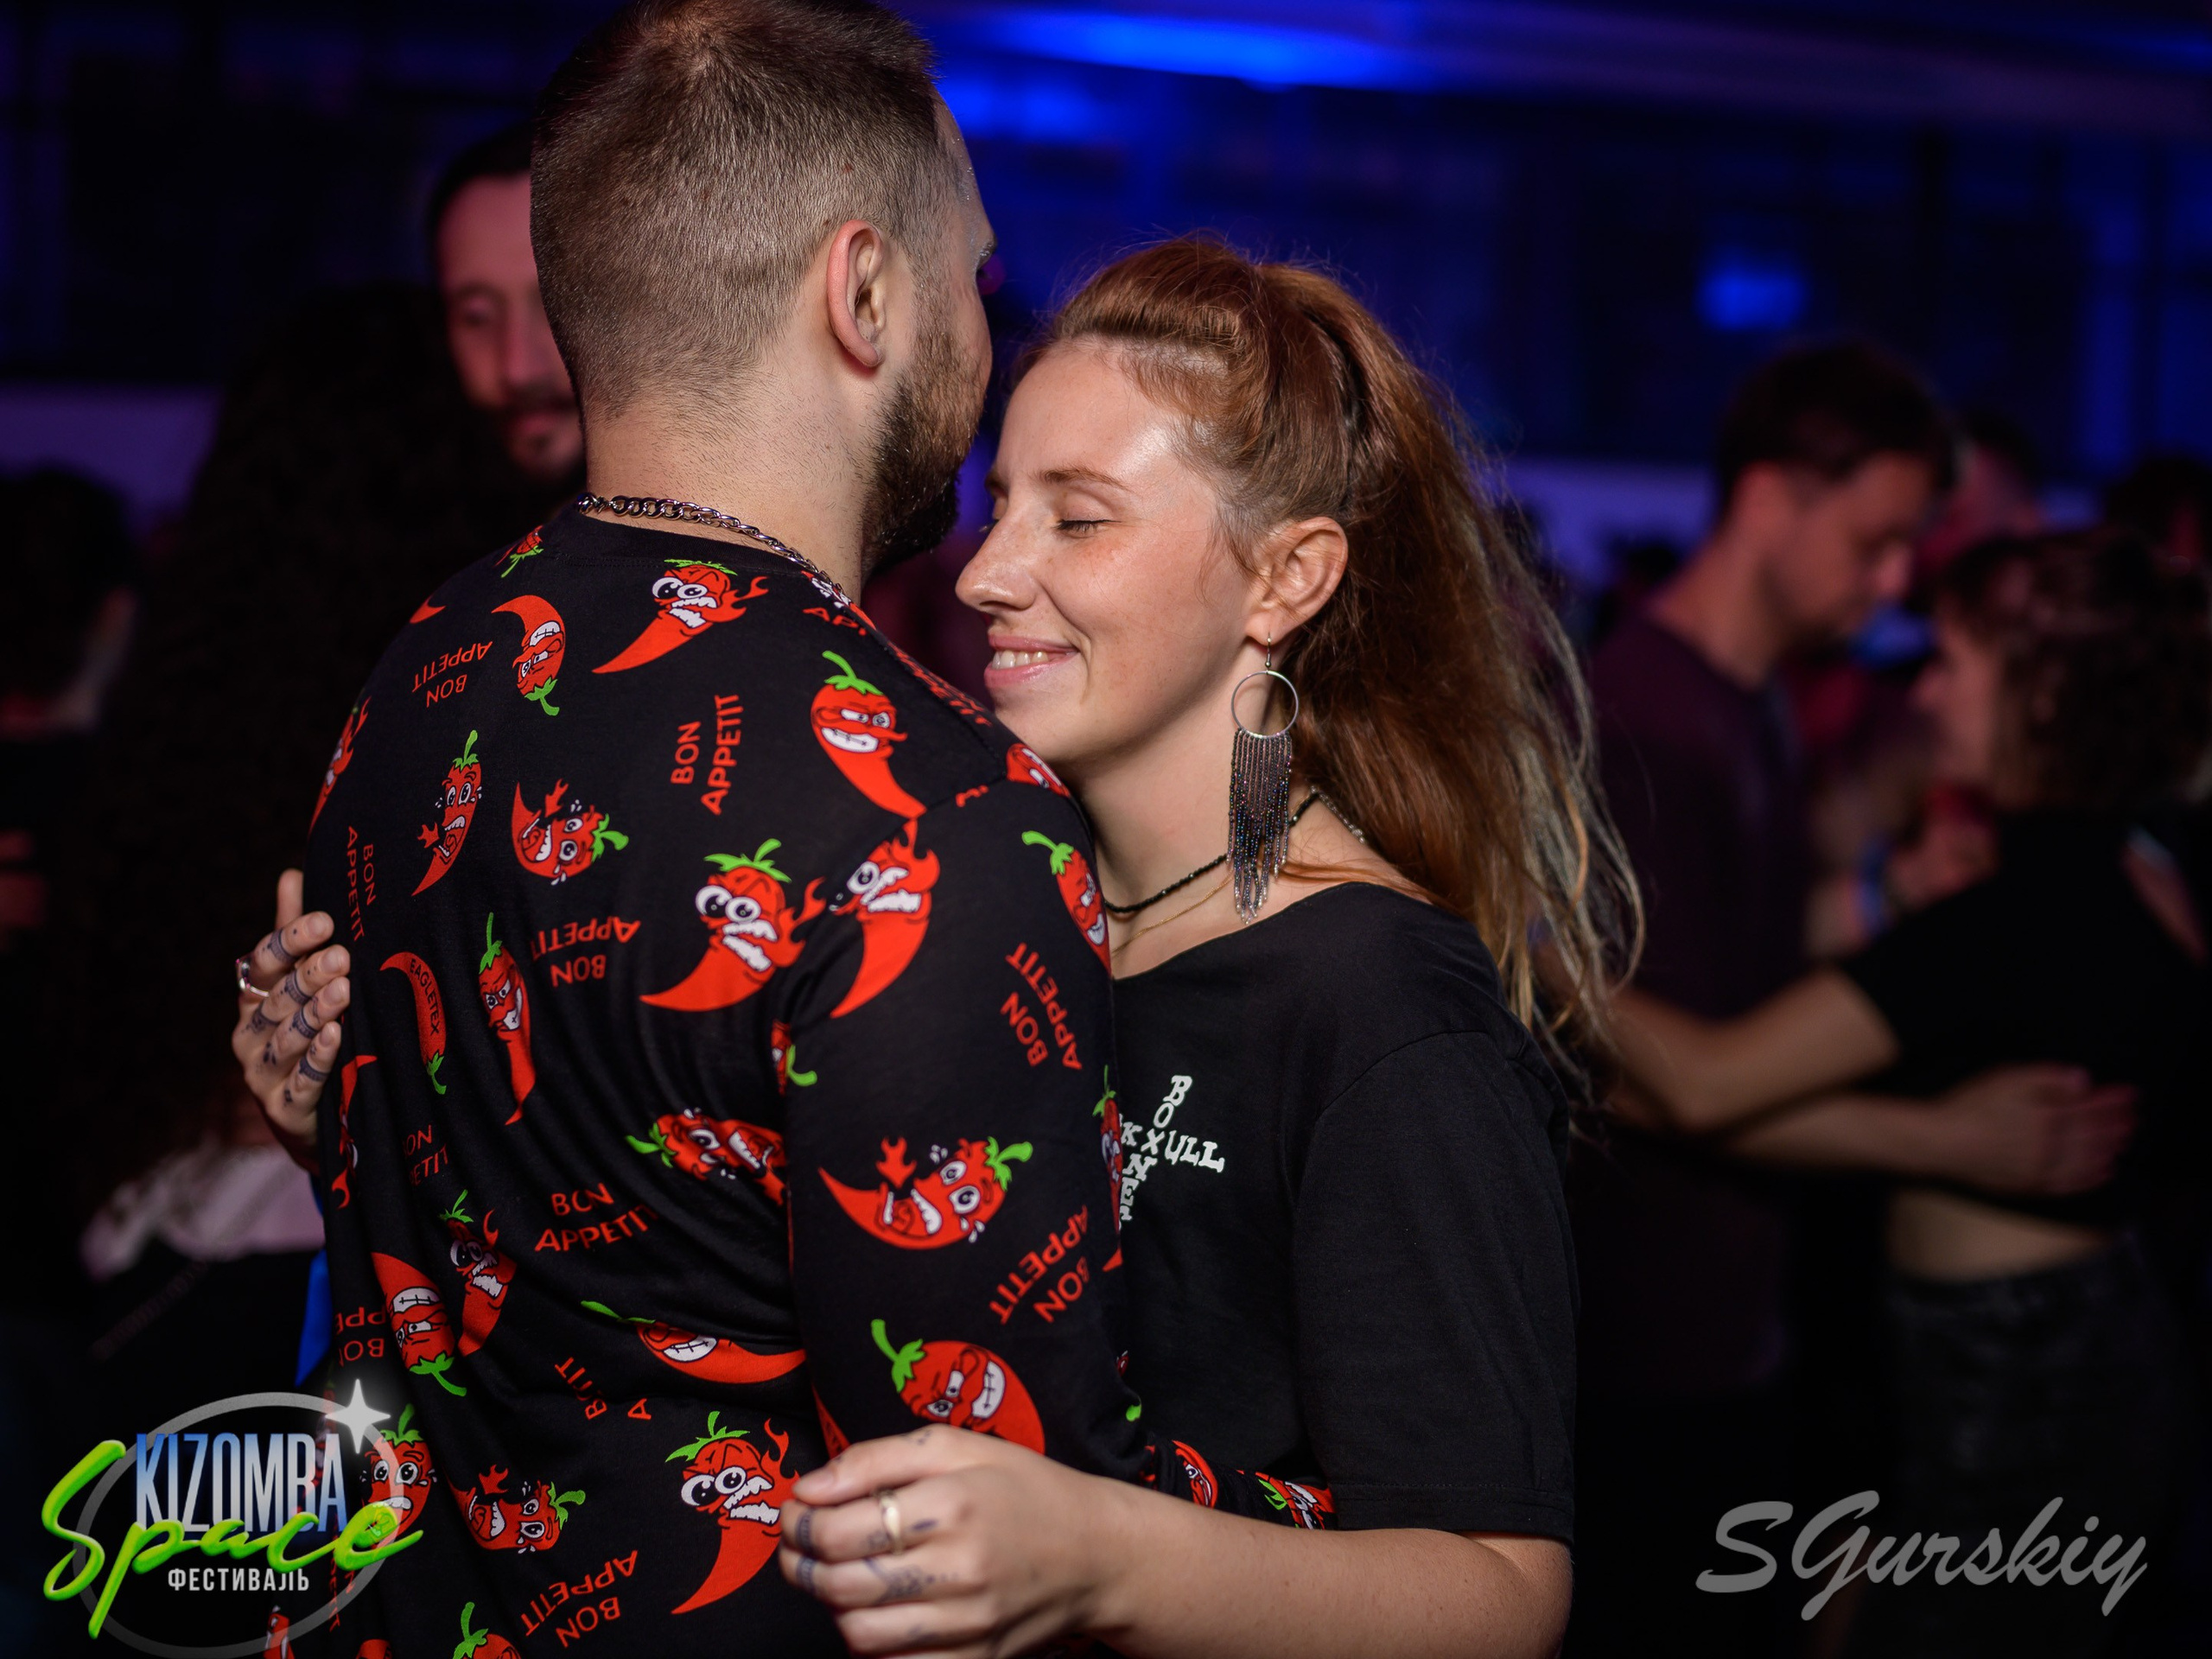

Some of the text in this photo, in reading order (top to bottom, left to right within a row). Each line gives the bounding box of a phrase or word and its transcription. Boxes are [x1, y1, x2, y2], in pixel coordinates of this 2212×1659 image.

[411, 640, 493, 693] APPETIT
[426, 673, 468, 709] BON
[671, 721, 702, 785] BON
[700, 694, 745, 816] APPETIT
[346, 824, 365, 942] APPETIT
[363, 842, 377, 906] BON
[529, 915, 643, 963] APPETIT
[550, 953, 607, 988] BON
[409, 958, 441, 1036] EAGLETEX
[1000, 990, 1049, 1067] BON
[1004, 941, 1084, 1071] APPETIT
[401, 1122, 433, 1158] ON
[988, 1203, 1089, 1326] APPETIT
[1033, 1255, 1090, 1324] BON
[520, 1548, 639, 1637] APPETIT
[555, 1594, 621, 1649] BON
